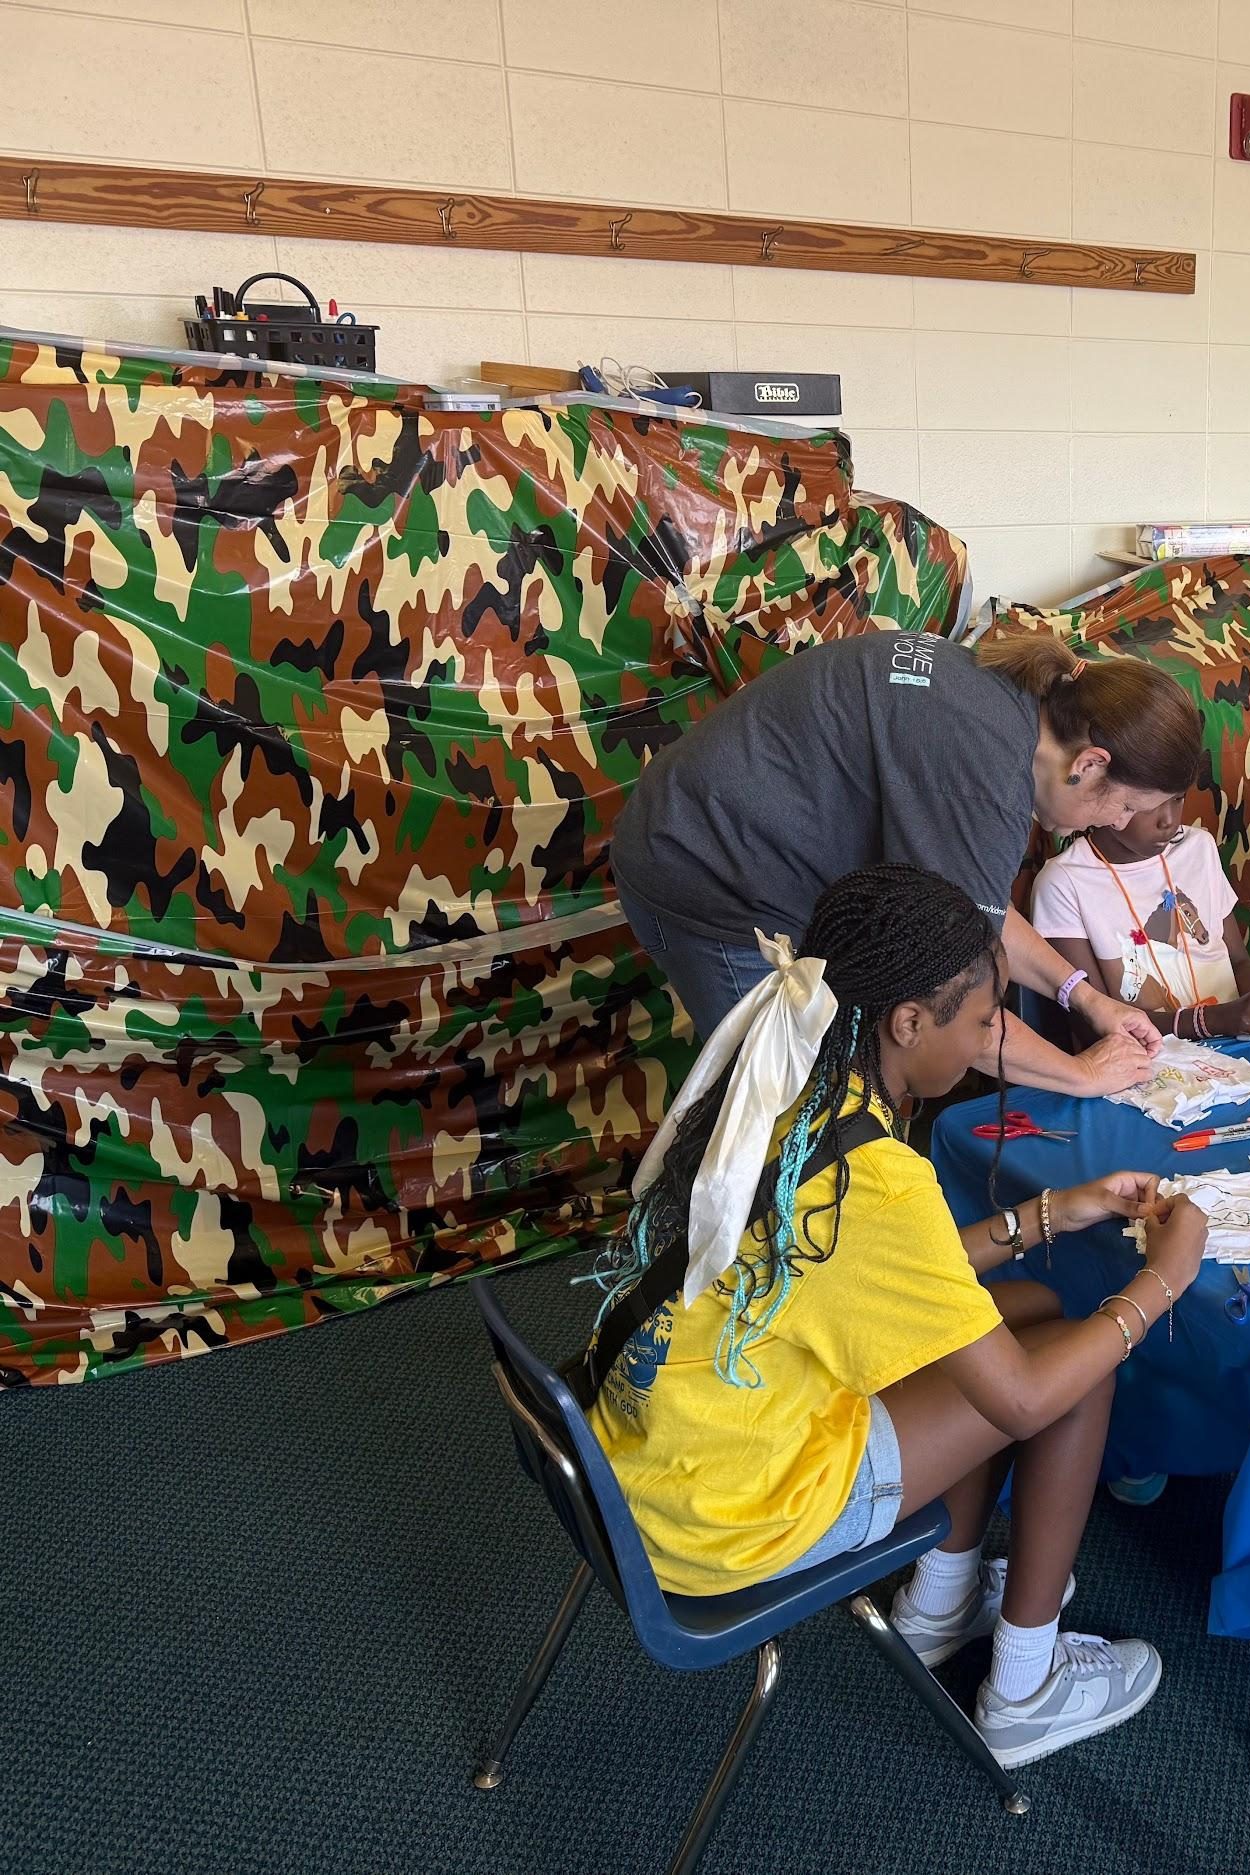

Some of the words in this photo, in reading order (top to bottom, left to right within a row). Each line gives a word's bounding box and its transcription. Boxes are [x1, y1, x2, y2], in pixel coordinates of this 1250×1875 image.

[758, 385, 796, 398] Bible
[892, 638, 915, 670] YOU
[620, 1400, 638, 1418] GOD
